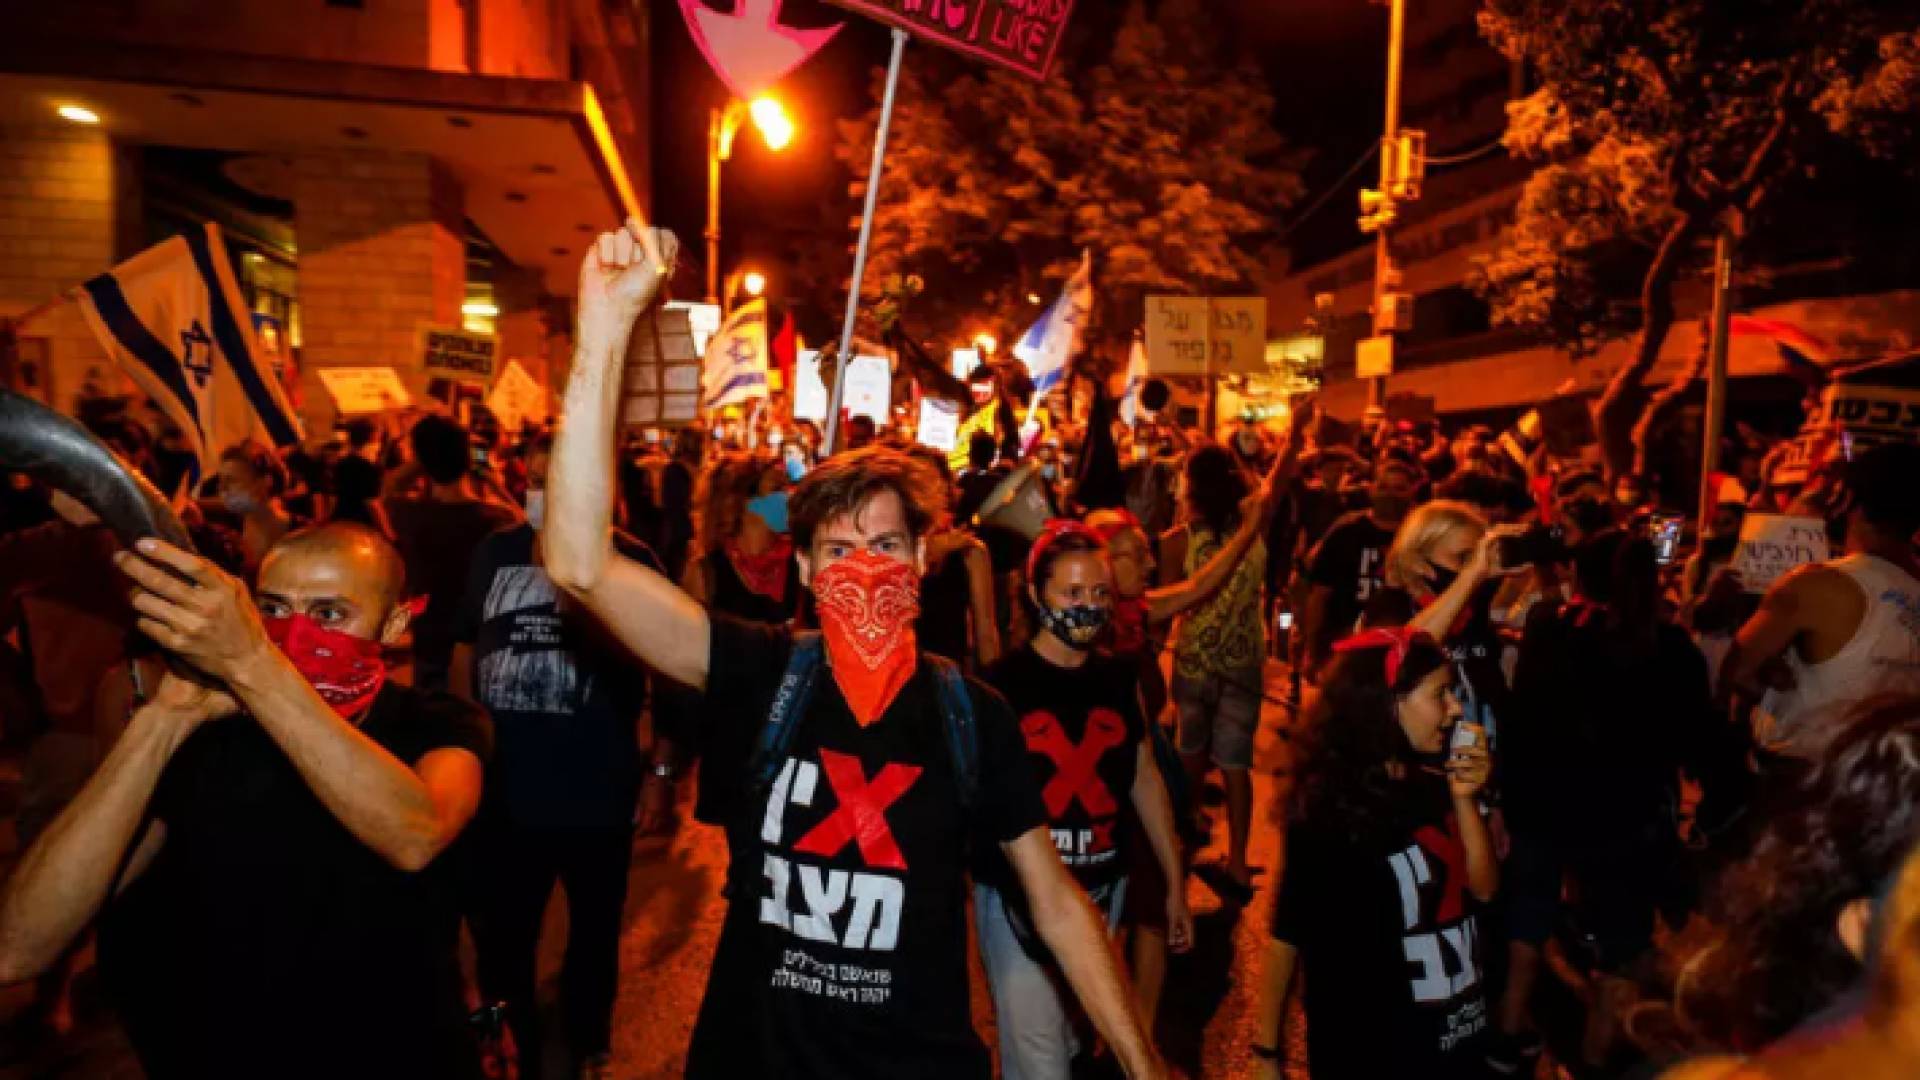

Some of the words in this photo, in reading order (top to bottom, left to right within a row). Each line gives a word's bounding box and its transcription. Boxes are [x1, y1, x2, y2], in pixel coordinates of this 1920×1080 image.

[990, 7, 1047, 62] LIKE
[759, 852, 906, 951] מצב
[1403, 914, 1477, 1002] צב
